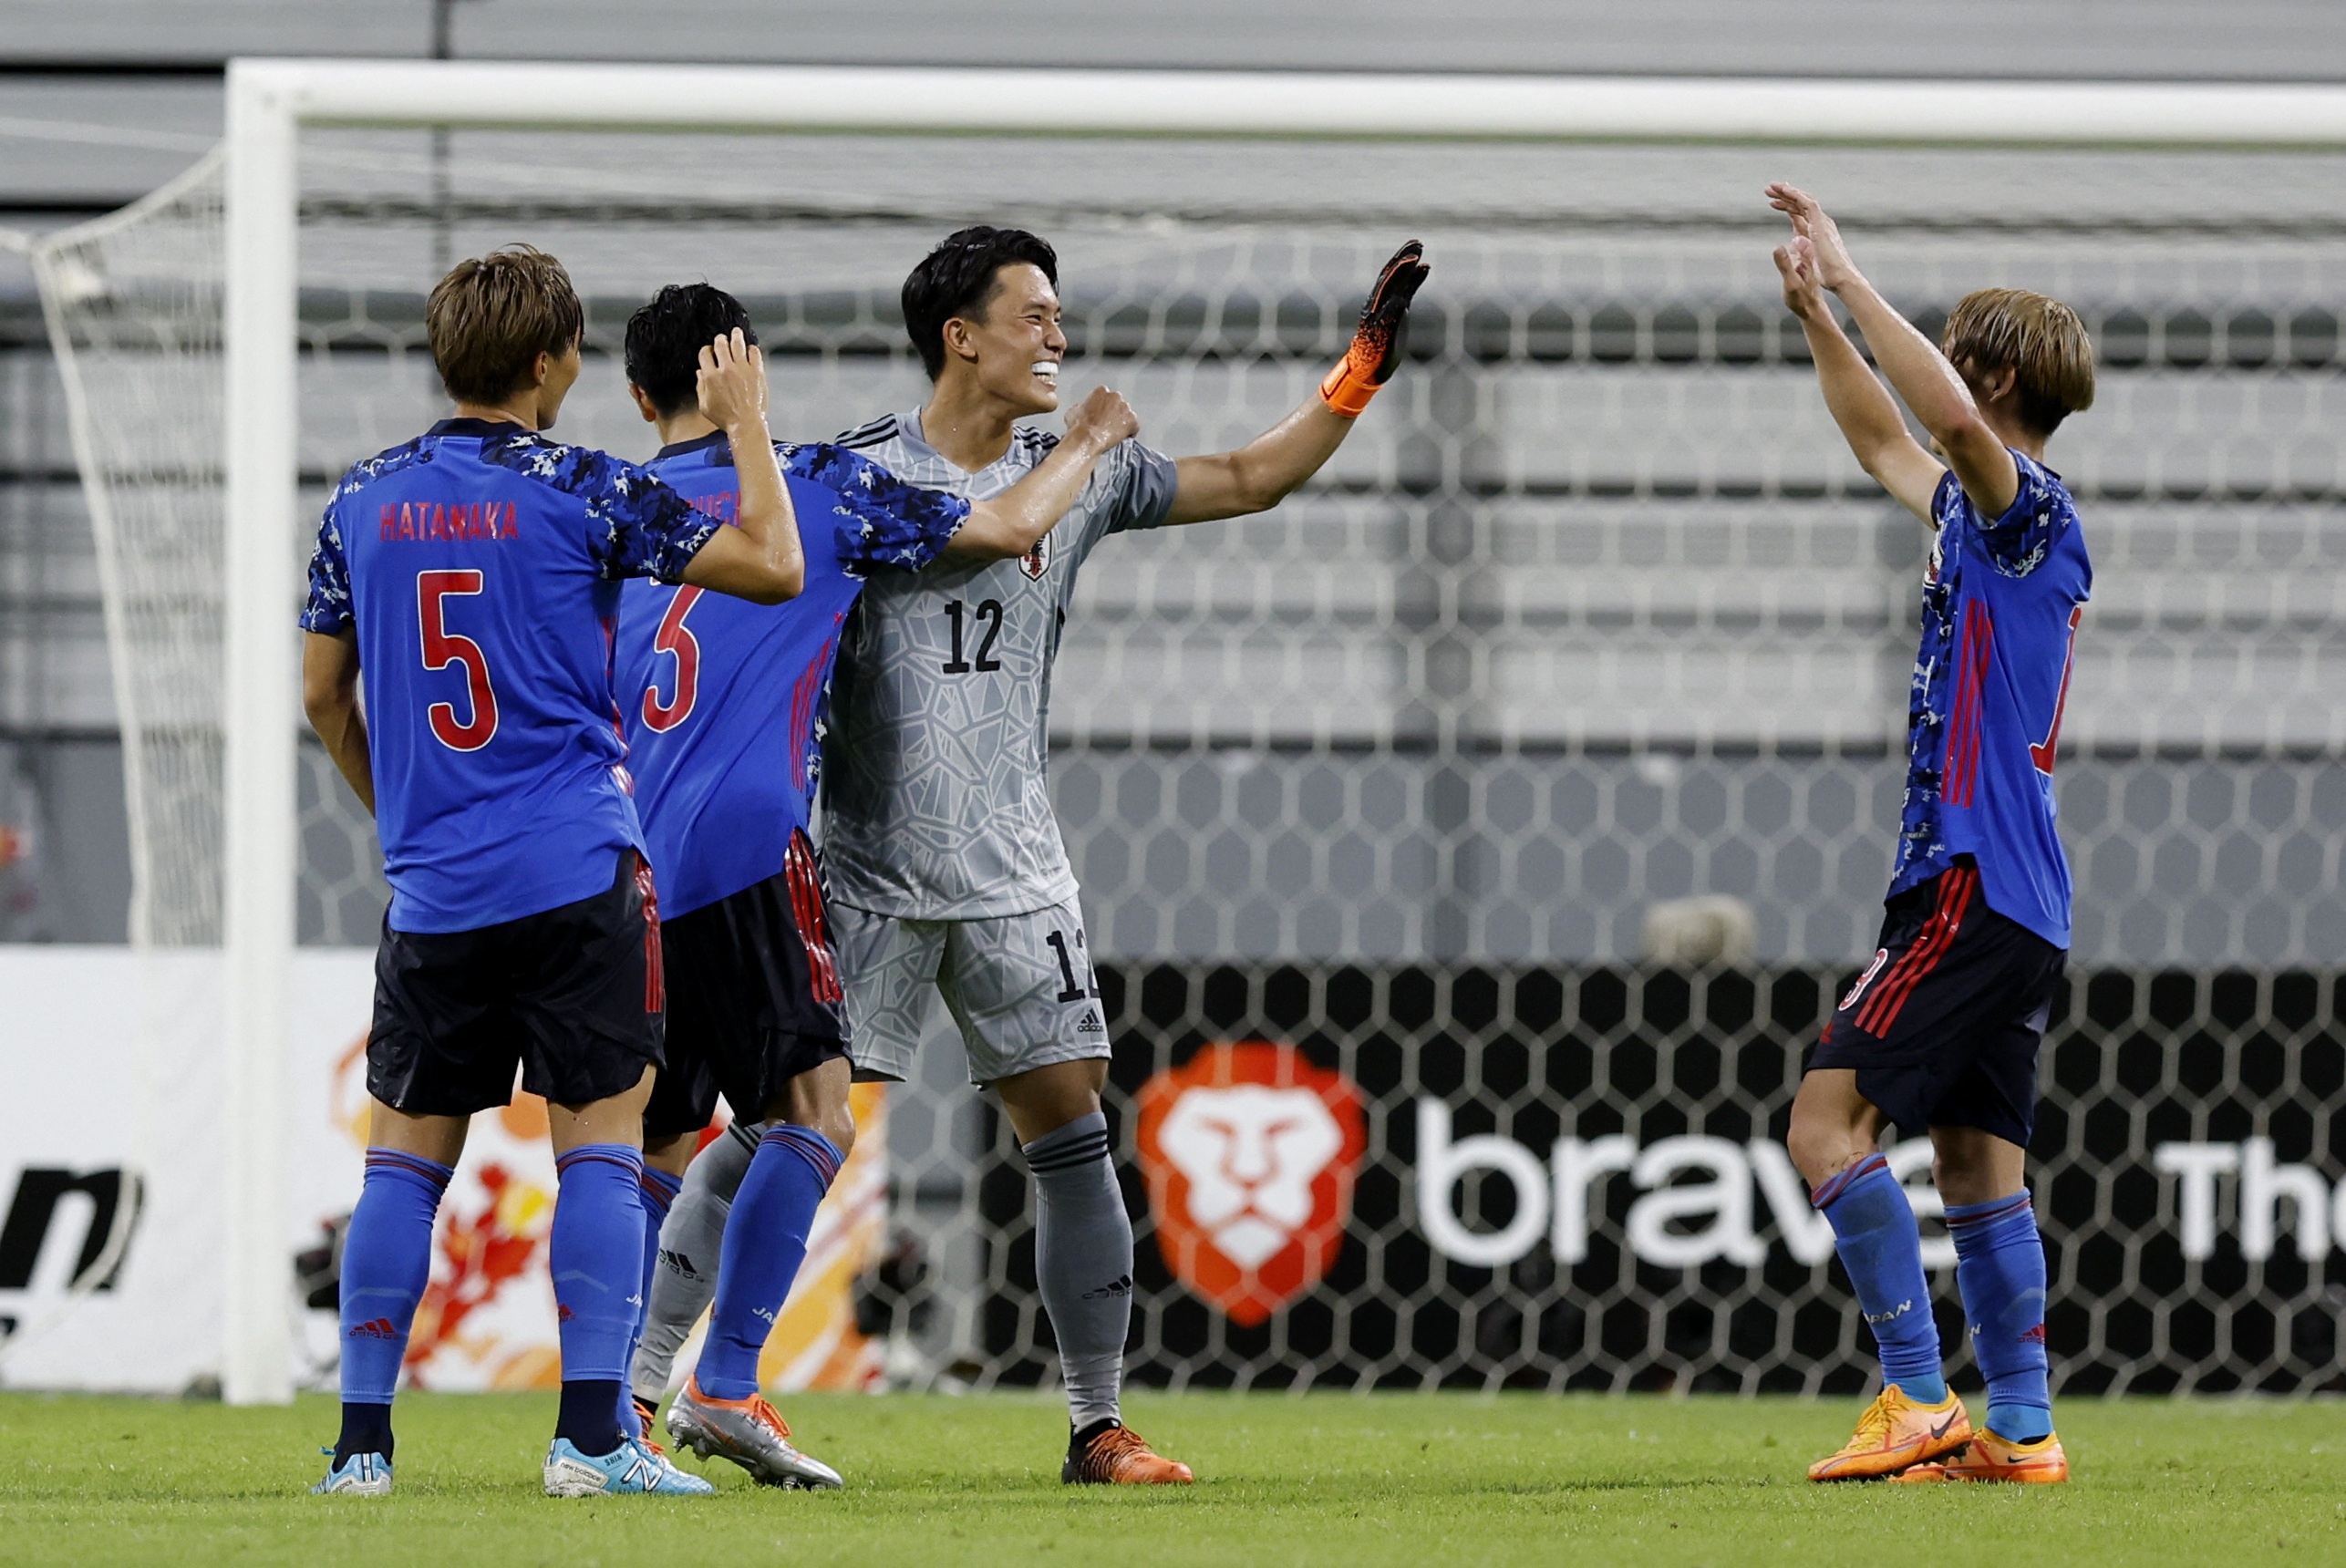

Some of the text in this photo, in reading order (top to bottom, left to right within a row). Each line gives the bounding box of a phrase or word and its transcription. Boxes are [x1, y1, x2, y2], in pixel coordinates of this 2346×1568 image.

[379, 500, 520, 542] HATANAKA
[417, 569, 500, 752] 5
[642, 576, 705, 734] 3
[943, 599, 1003, 673] 12
[1077, 1024, 1103, 1033] adidas
[2153, 1136, 2346, 1263] Th
